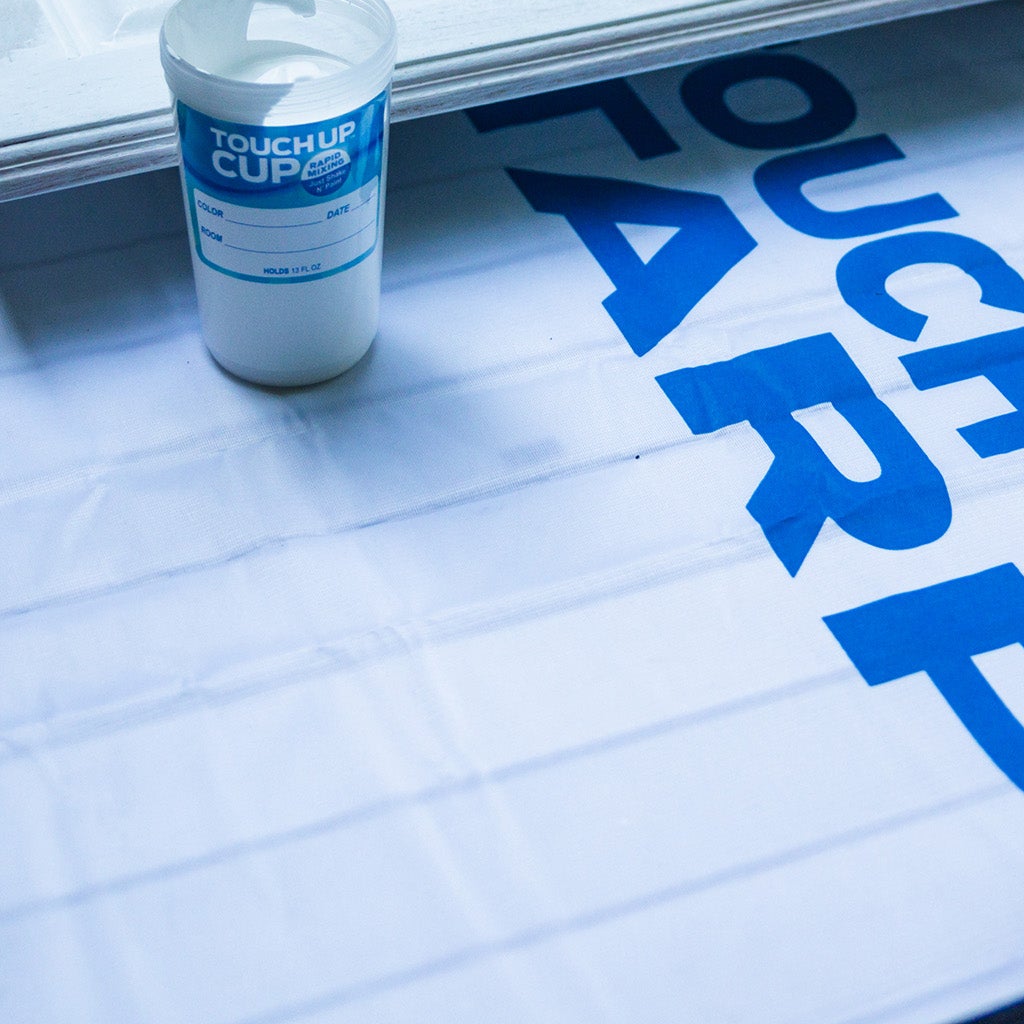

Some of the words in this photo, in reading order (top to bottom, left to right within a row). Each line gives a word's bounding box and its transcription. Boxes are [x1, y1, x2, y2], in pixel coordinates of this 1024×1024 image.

[210, 127, 315, 156] TOUCH
[318, 120, 356, 149] UP
[212, 149, 301, 184] CUP
[307, 158, 345, 178] MIXING
[310, 152, 342, 170] RAPID
[197, 199, 224, 218] COLOR
[326, 204, 350, 219] DATE
[201, 226, 223, 243] ROOM
[311, 263, 321, 271] OZ
